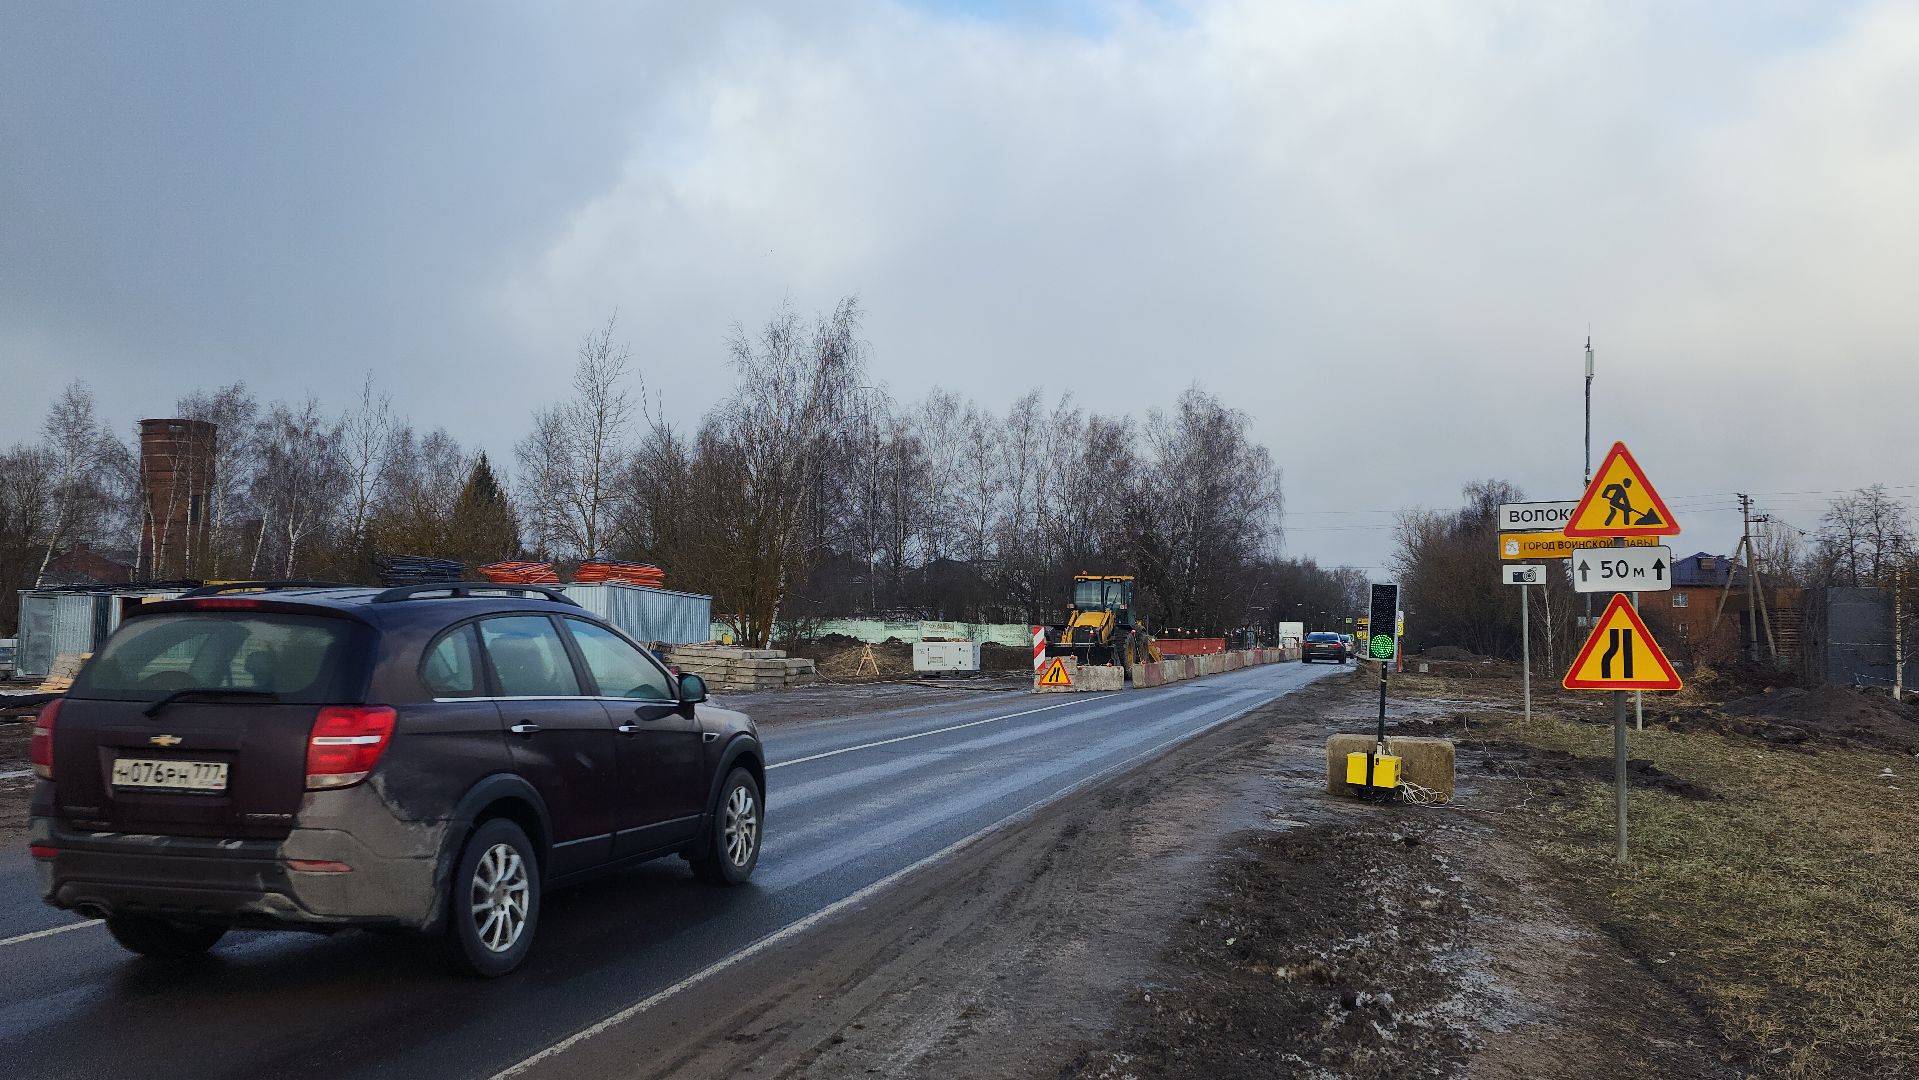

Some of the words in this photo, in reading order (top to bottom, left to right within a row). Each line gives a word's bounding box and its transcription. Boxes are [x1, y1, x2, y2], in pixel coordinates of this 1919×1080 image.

[1509, 508, 1576, 523] ВОЛОК
[1523, 541, 1555, 551] ГОРОД
[1558, 538, 1613, 549] ВОИНСКОЙ
[1601, 559, 1629, 579] 50
[194, 763, 221, 780] 777
